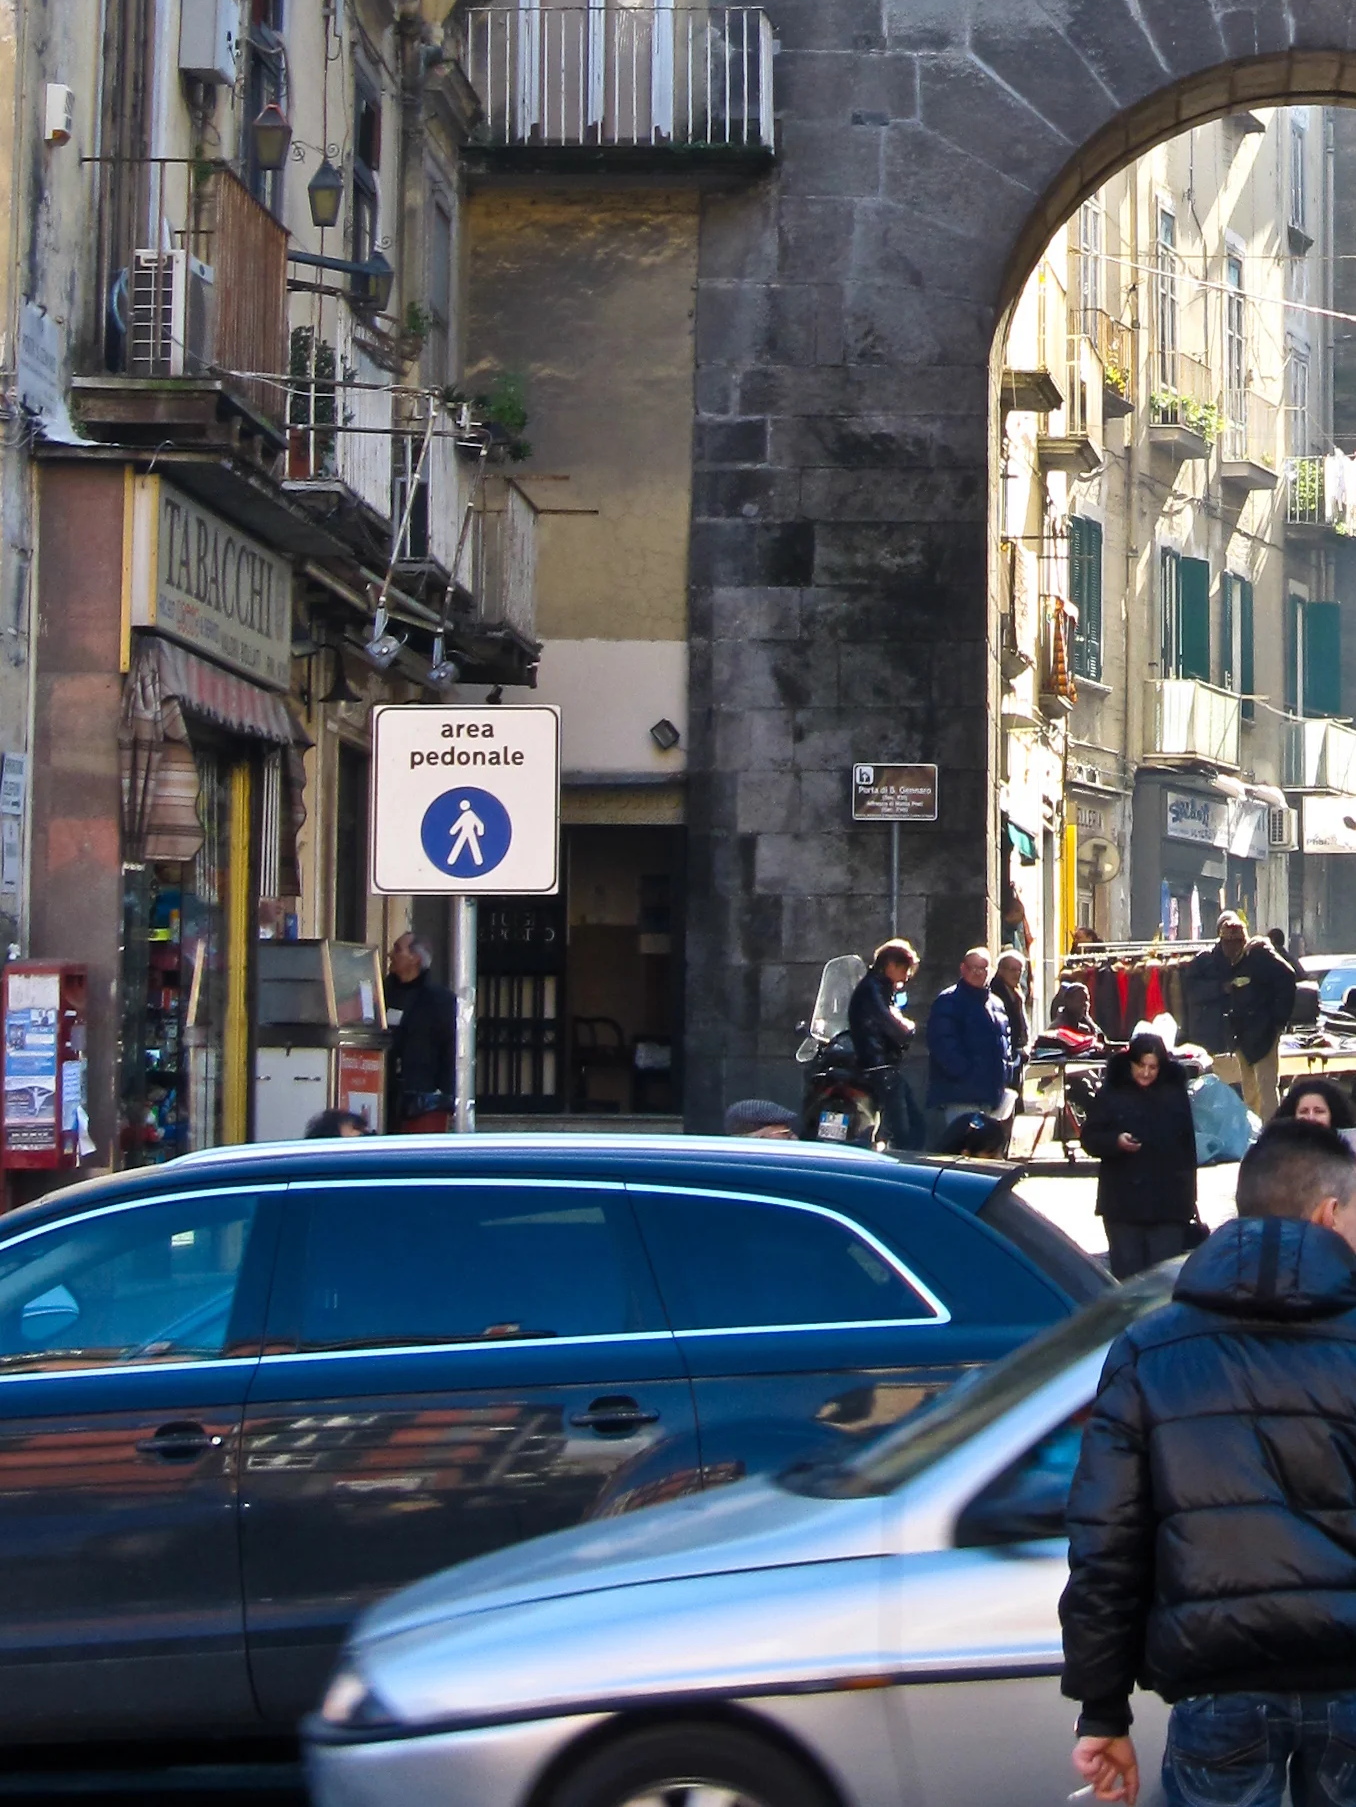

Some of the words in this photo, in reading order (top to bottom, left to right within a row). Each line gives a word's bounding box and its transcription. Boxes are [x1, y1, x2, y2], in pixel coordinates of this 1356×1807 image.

[164, 497, 274, 640] TABACCHI
[441, 723, 495, 738] area
[410, 746, 525, 770] pedonale
[858, 786, 879, 794] Porta
[880, 786, 888, 794] di
[899, 786, 932, 795] Gennaro
